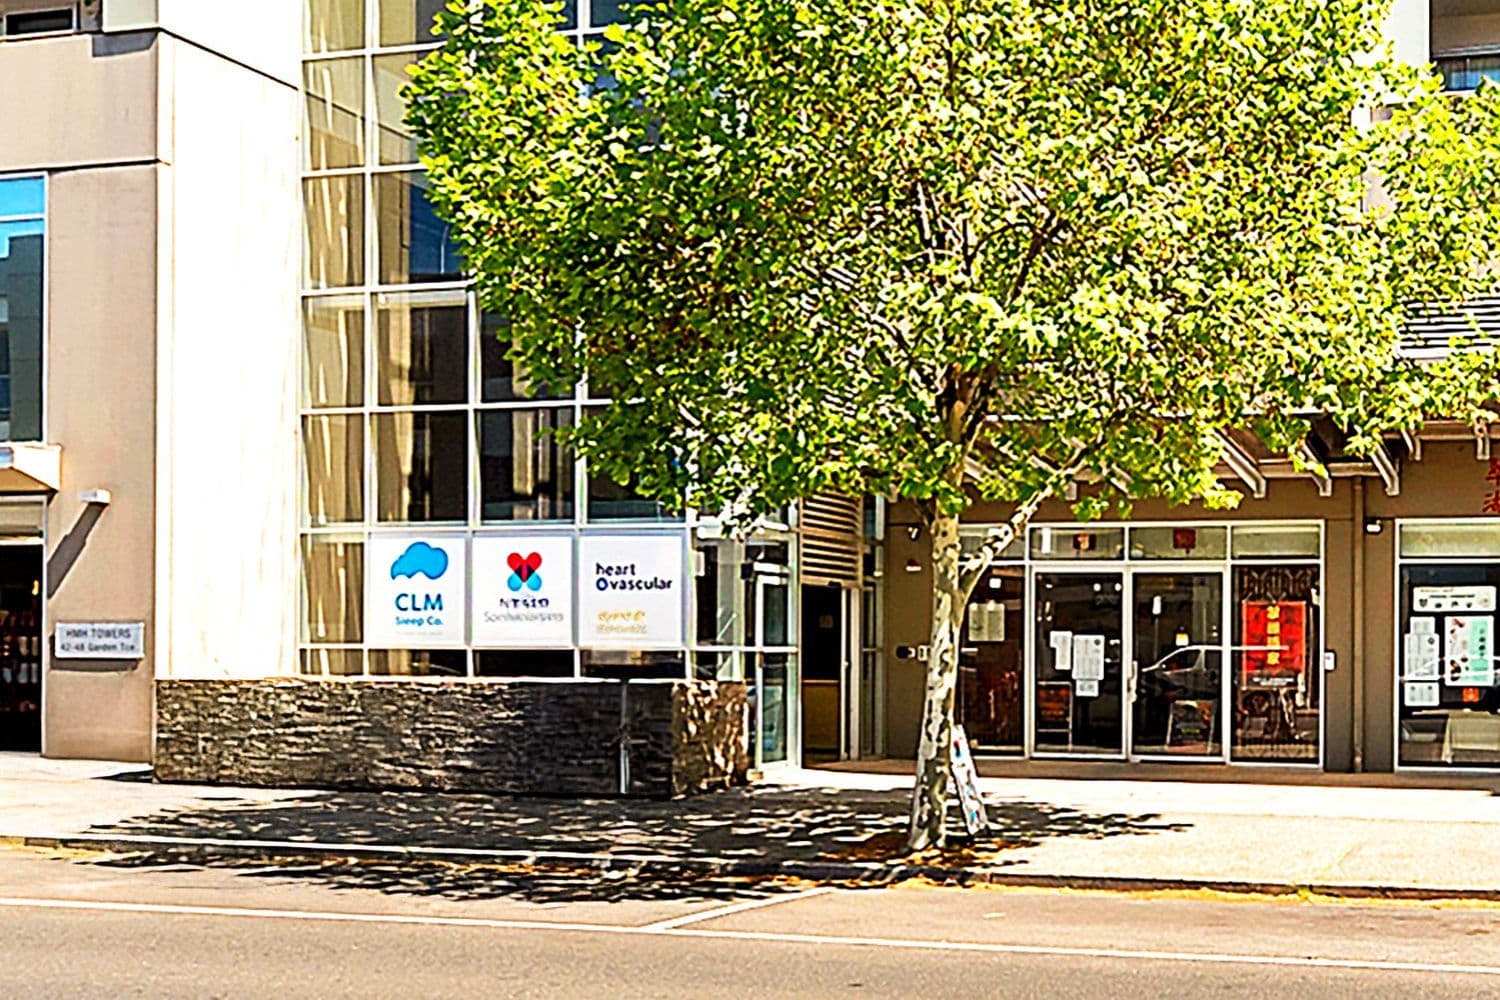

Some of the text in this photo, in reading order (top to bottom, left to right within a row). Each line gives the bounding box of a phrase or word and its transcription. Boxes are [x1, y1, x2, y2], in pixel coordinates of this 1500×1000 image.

[595, 562, 636, 576] heart
[394, 592, 444, 612] CLM
[91, 627, 132, 639] TOWERS
